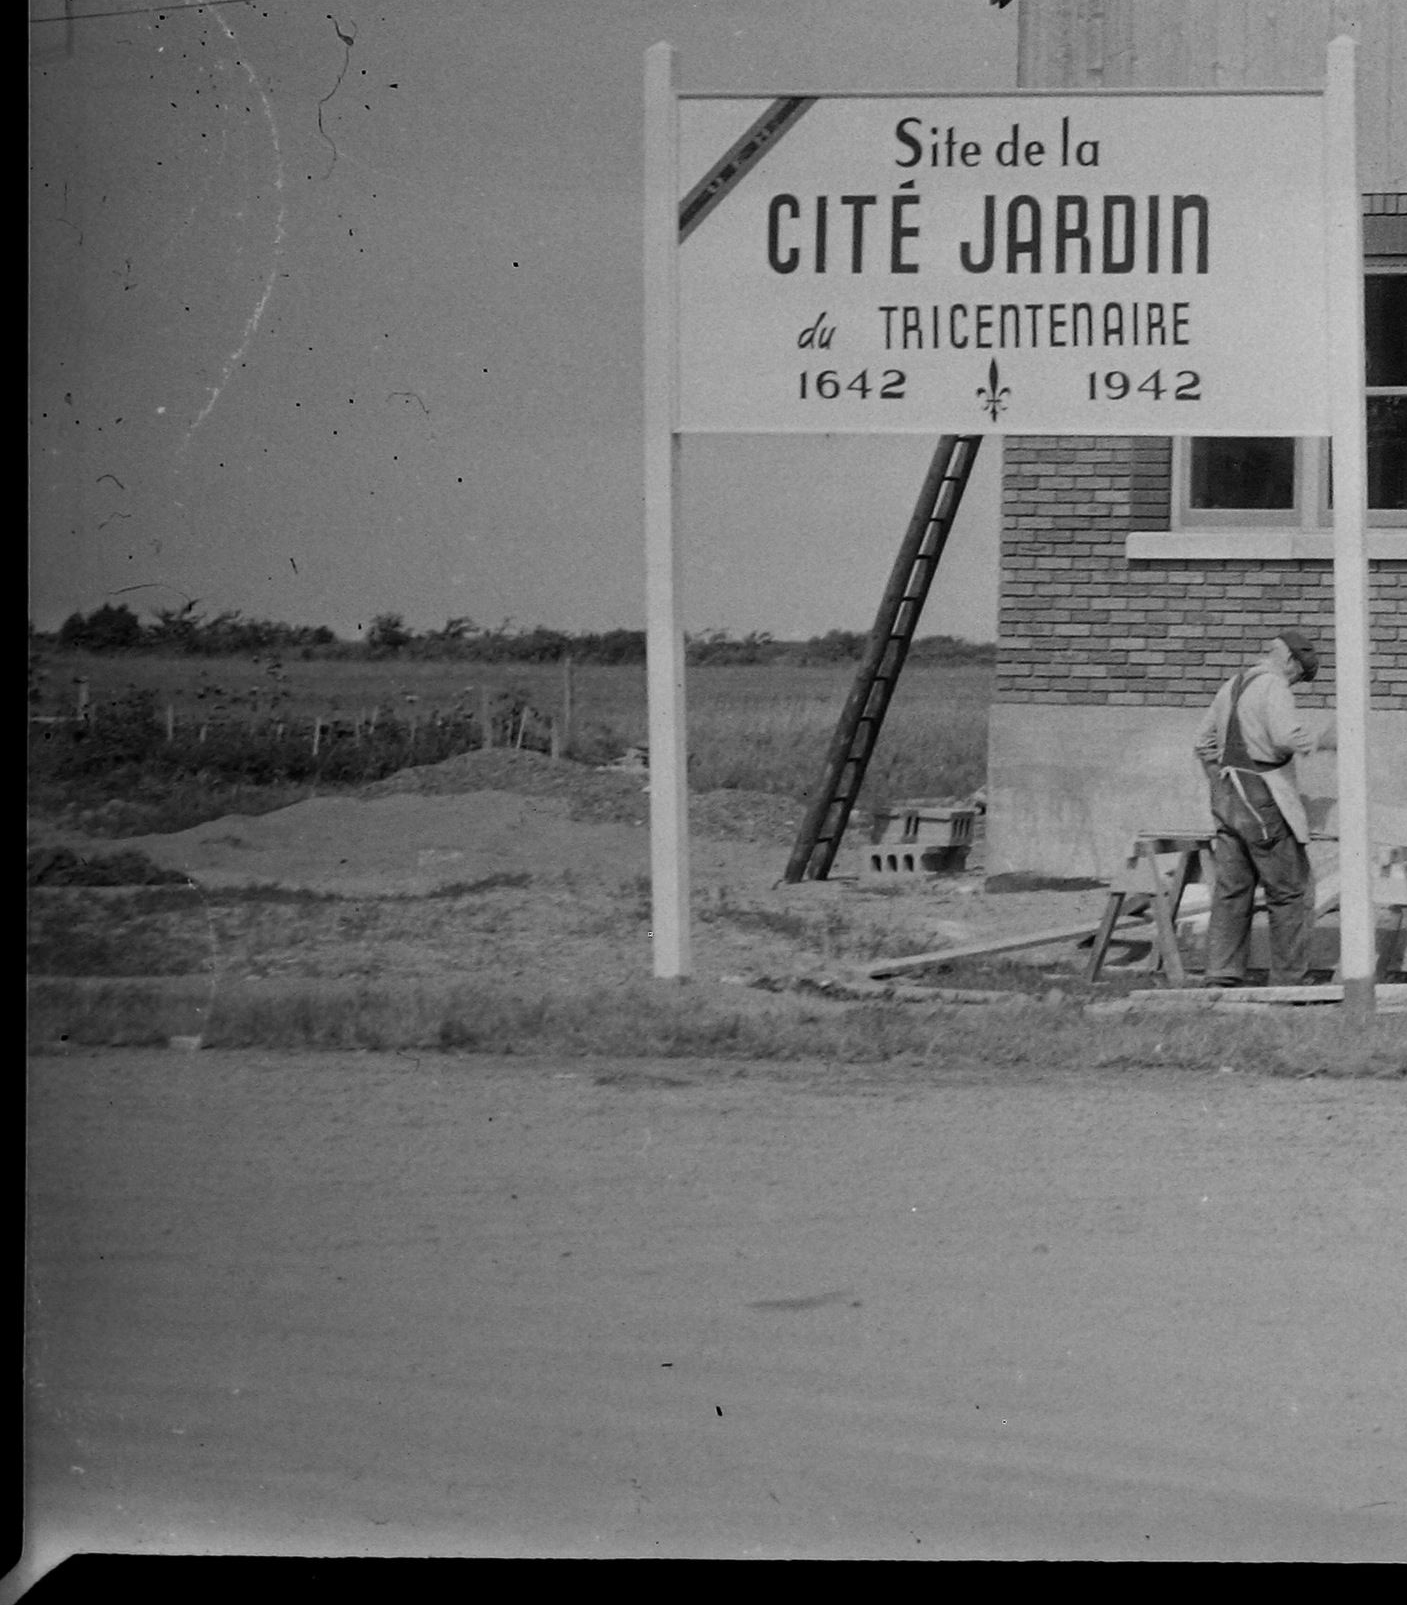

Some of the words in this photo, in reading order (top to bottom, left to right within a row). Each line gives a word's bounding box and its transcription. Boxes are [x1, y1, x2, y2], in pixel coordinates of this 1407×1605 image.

[896, 117, 981, 168] Site
[996, 124, 1045, 167] de
[1062, 116, 1099, 166] la
[768, 180, 920, 274] CITÉ
[960, 195, 1208, 274] JARDIN
[797, 312, 836, 349] du
[878, 302, 1189, 349] TRICENTENAIRE
[800, 370, 906, 399] 1642
[1090, 370, 1200, 400] 1942
